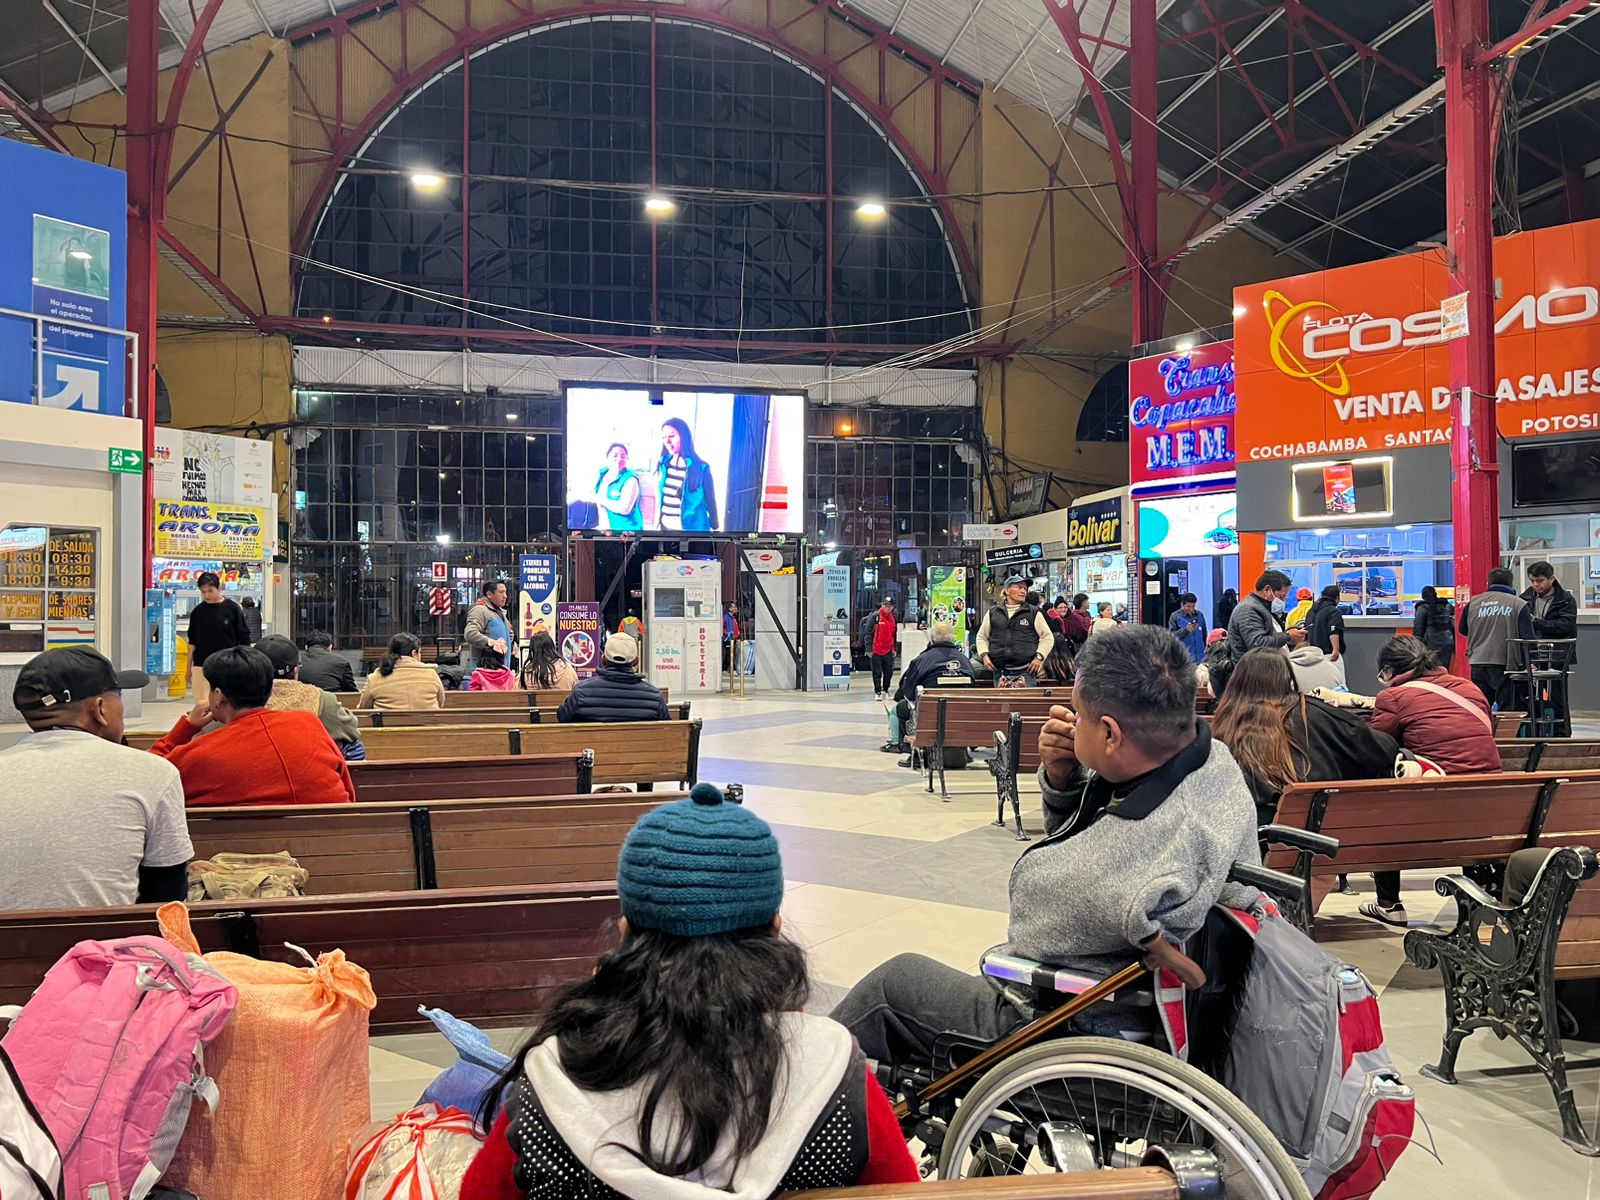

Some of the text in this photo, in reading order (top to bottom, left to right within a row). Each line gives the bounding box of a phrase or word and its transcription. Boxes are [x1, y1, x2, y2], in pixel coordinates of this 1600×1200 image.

[50, 298, 94, 313] No solo eres
[59, 310, 93, 322] operador,
[1303, 312, 1374, 331] FLOTA
[48, 325, 95, 339] del progreso
[1333, 366, 1600, 422] VENTA D ASAJES
[1521, 413, 1598, 434] POTOSI
[1249, 436, 1368, 460] COCHABAMBA
[158, 520, 261, 537] AROMA
[49, 540, 62, 552] DE
[63, 541, 94, 553] SALIDA
[52, 553, 91, 563] 08:30
[49, 595, 60, 605] DE
[559, 611, 598, 620] CONSUME LO
[1477, 605, 1513, 618] MOPAR
[559, 620, 597, 631] NUESTRO
